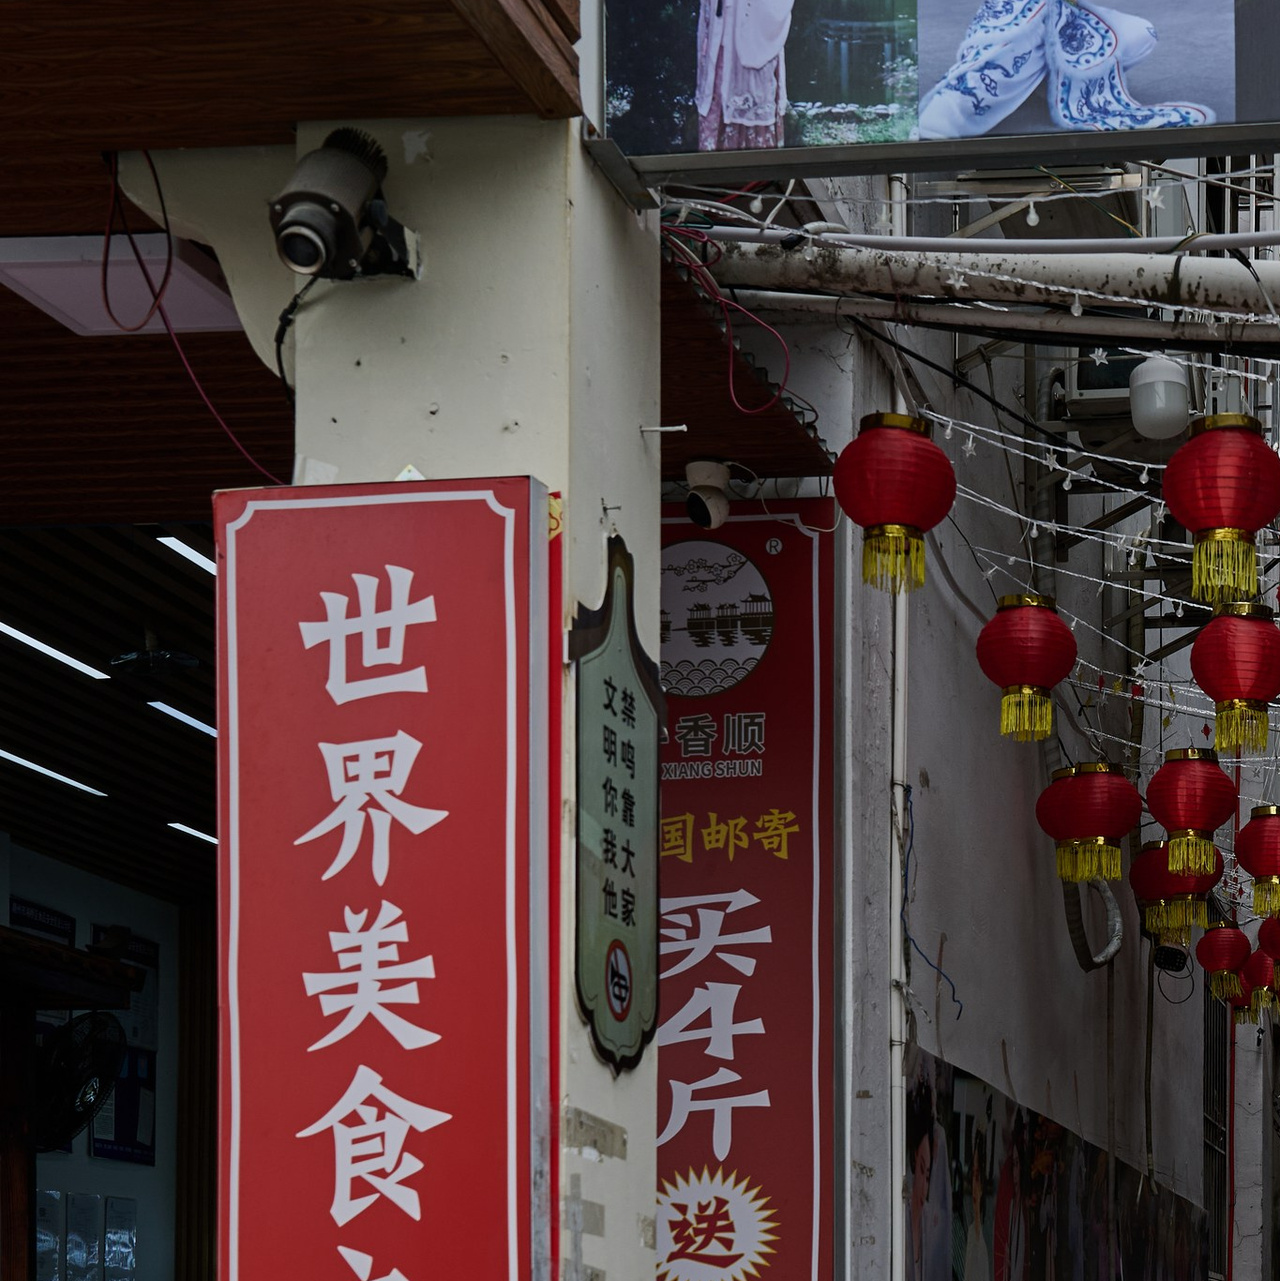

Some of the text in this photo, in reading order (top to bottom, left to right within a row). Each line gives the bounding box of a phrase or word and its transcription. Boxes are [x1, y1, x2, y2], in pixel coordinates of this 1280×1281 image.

[602, 675, 619, 921] 文明你我他
[660, 712, 766, 757] 香顺
[662, 759, 763, 780] XIANG SHUN
[620, 686, 637, 929] 禁鸣靠大家
